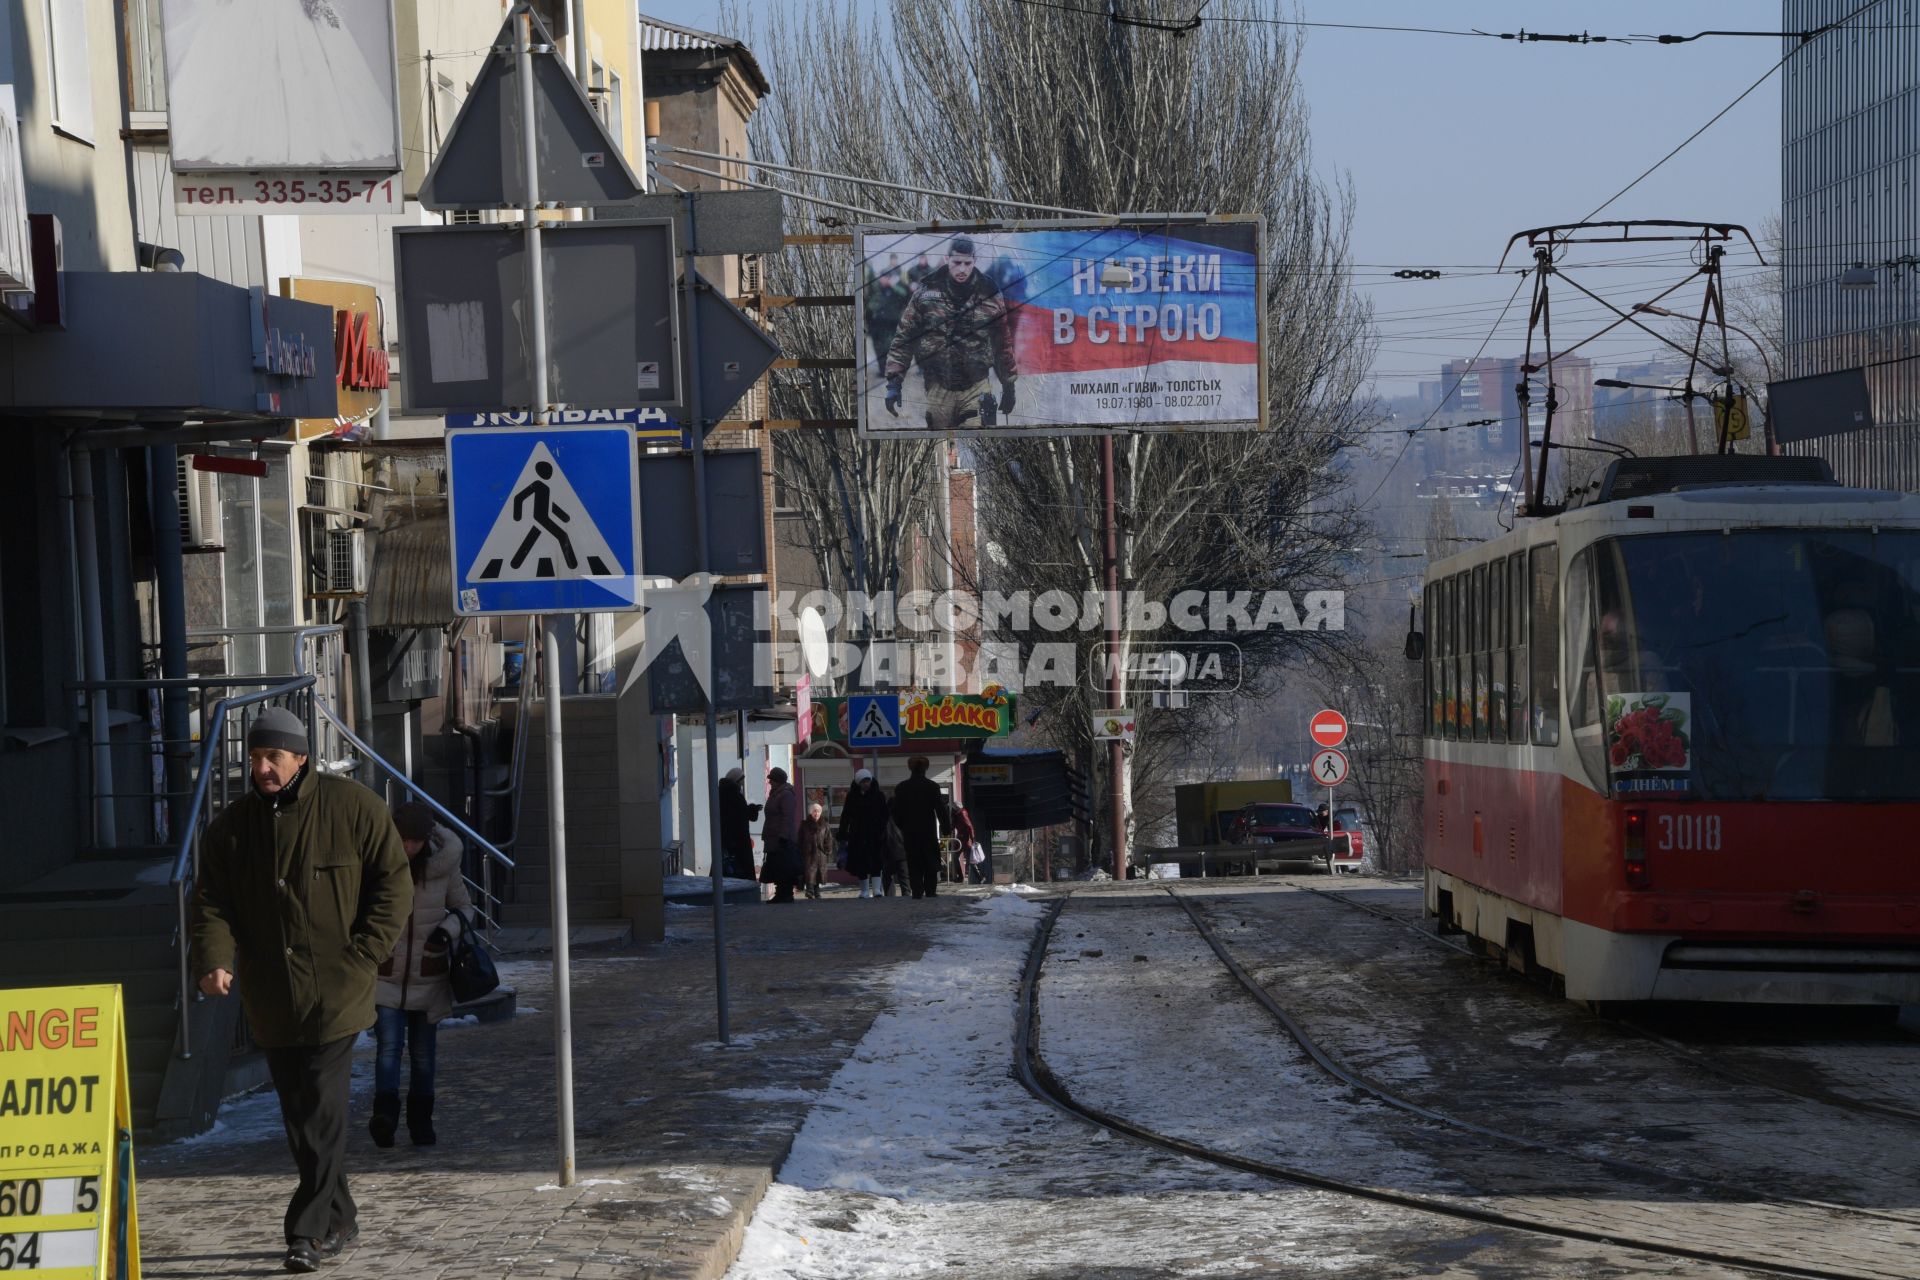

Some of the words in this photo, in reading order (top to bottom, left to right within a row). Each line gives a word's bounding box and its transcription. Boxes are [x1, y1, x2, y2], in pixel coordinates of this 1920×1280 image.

[182, 186, 243, 204] тел.
[255, 180, 392, 204] 335-35-71
[1053, 308, 1076, 344] В
[1087, 302, 1221, 344] СТРОЮ
[1070, 383, 1119, 395] МИХАИЛ
[1122, 381, 1163, 394] «ГИВИ»
[1166, 379, 1221, 393] ТОЛСТЫХ
[1096, 397, 1153, 409] 19.07.1980
[1165, 394, 1222, 408] 08.02.2017
[905, 697, 999, 731] Пчёлка
[1628, 776, 1675, 792] ДНЁМ
[1658, 814, 1722, 850] 3018
[0, 1007, 98, 1052] NGE
[0, 1141, 101, 1158] ПРОДАЖА
[77, 1175, 98, 1212] 5
